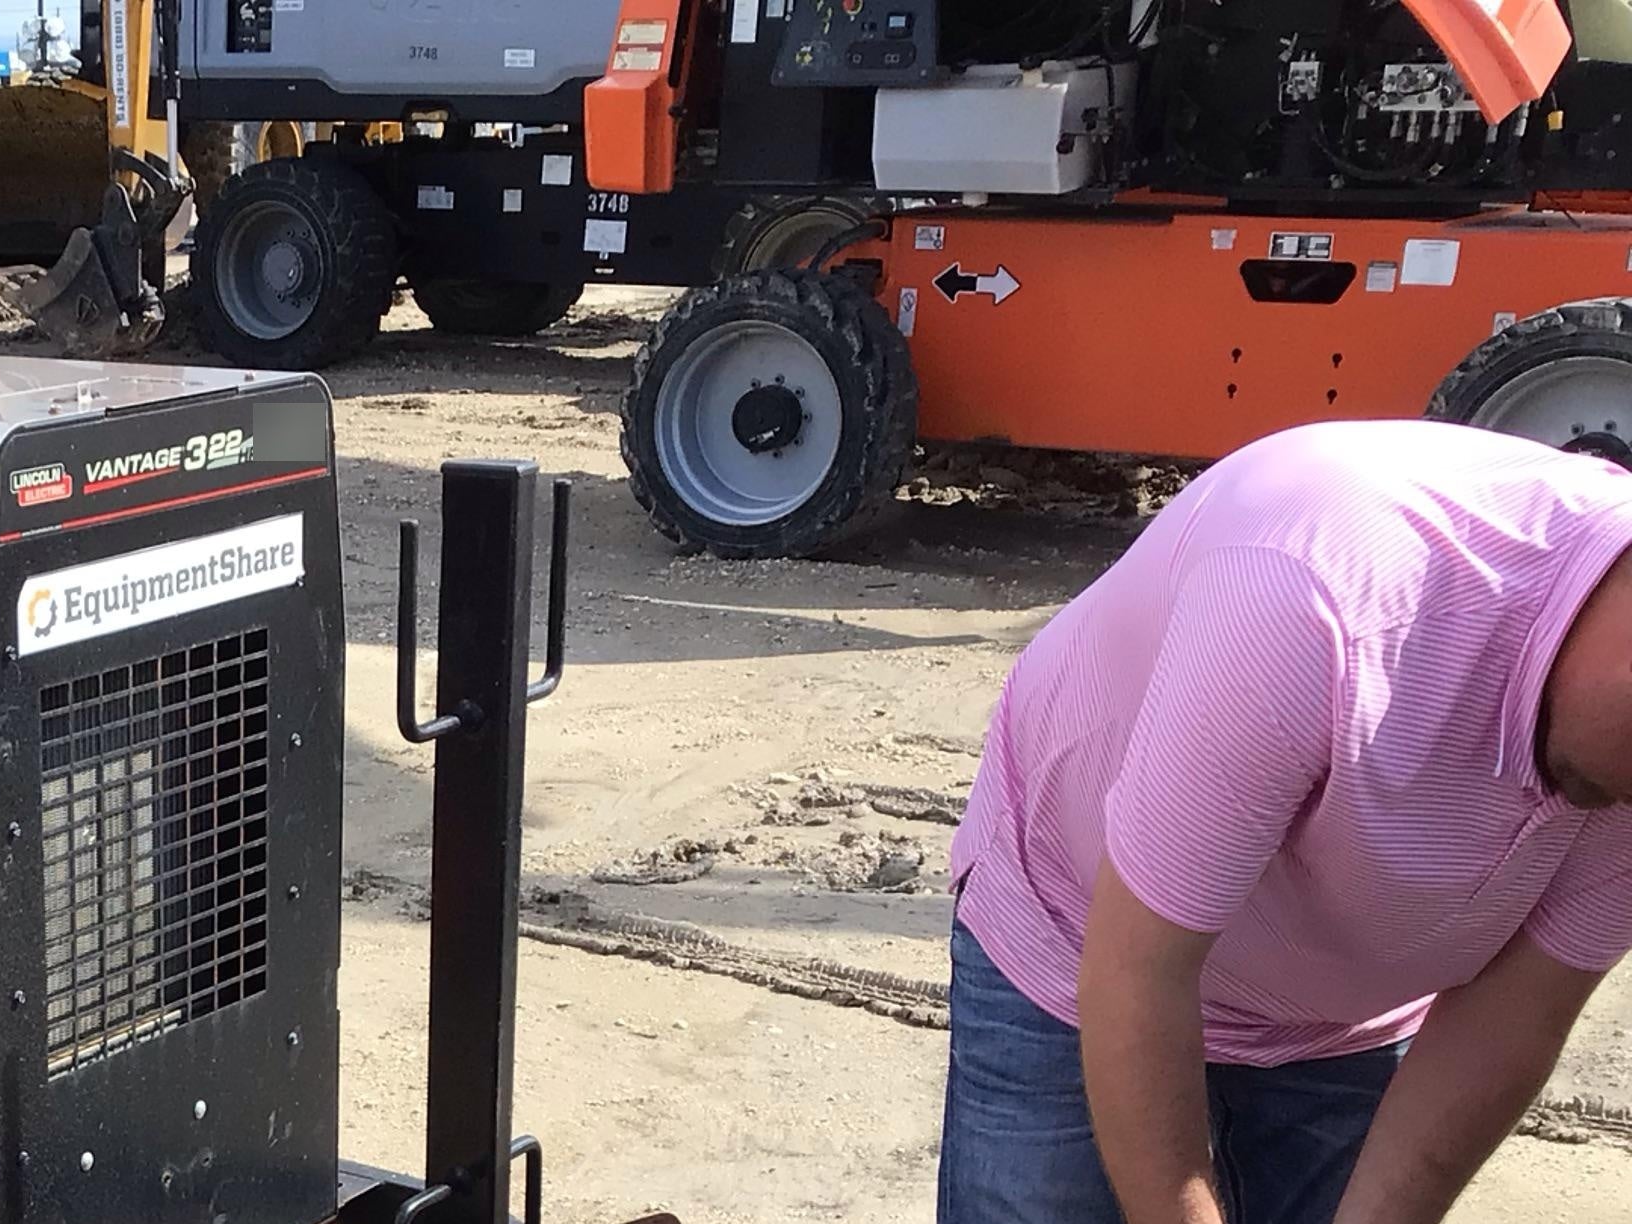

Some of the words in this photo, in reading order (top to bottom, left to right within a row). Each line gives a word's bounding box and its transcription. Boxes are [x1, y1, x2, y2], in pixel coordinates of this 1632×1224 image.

[409, 46, 438, 60] 3748
[588, 193, 629, 213] 3748
[85, 446, 182, 483] VANTAGE
[184, 429, 243, 471] 322
[13, 466, 63, 489] LINCOLN
[25, 484, 66, 503] ELECTRIC
[64, 541, 294, 624] EquipmentShare
